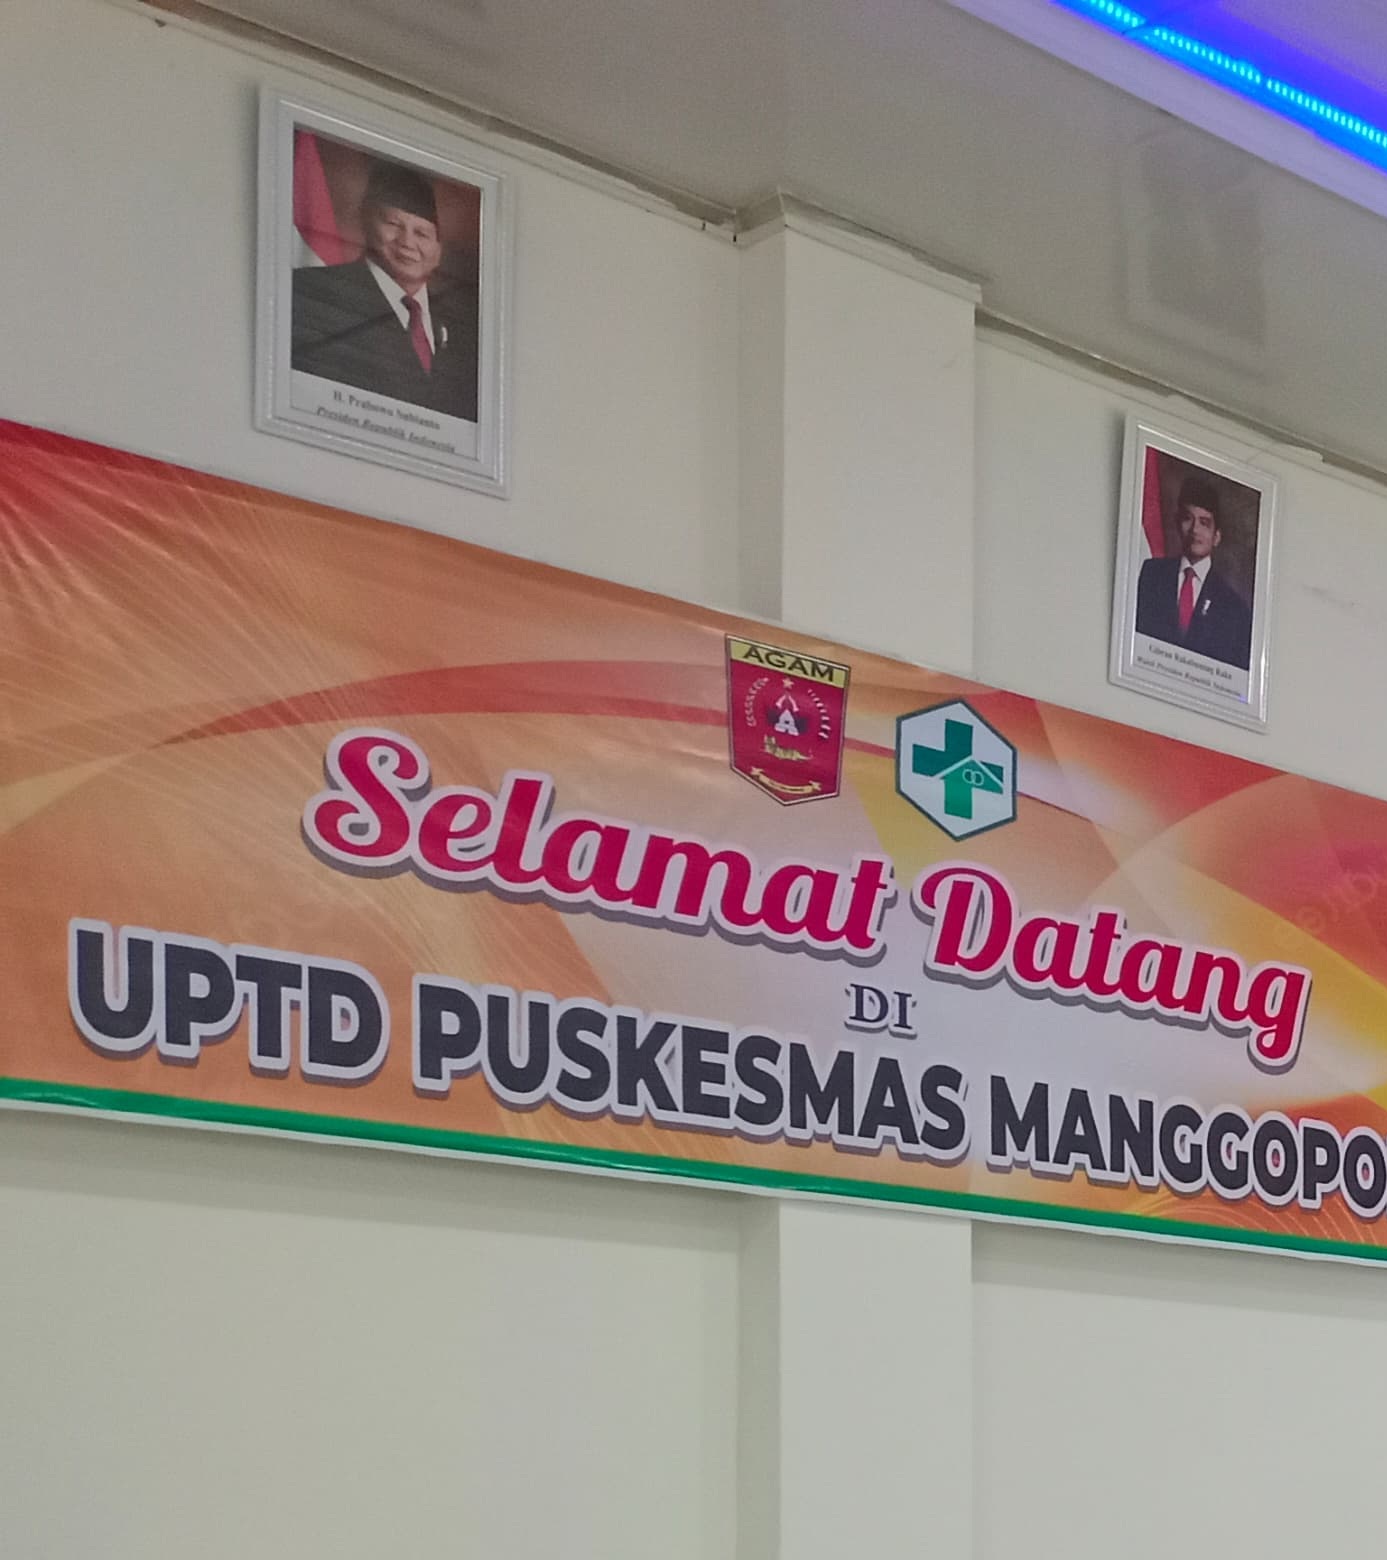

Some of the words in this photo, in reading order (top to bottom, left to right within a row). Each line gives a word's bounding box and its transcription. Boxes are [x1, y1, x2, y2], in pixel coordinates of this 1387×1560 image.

[743, 645, 835, 683] AGAM
[310, 733, 889, 953] Selamat
[918, 865, 1307, 1061] Datang
[74, 926, 385, 1072] UPTD
[417, 982, 968, 1151] PUSKESMAS
[848, 982, 915, 1030] DI
